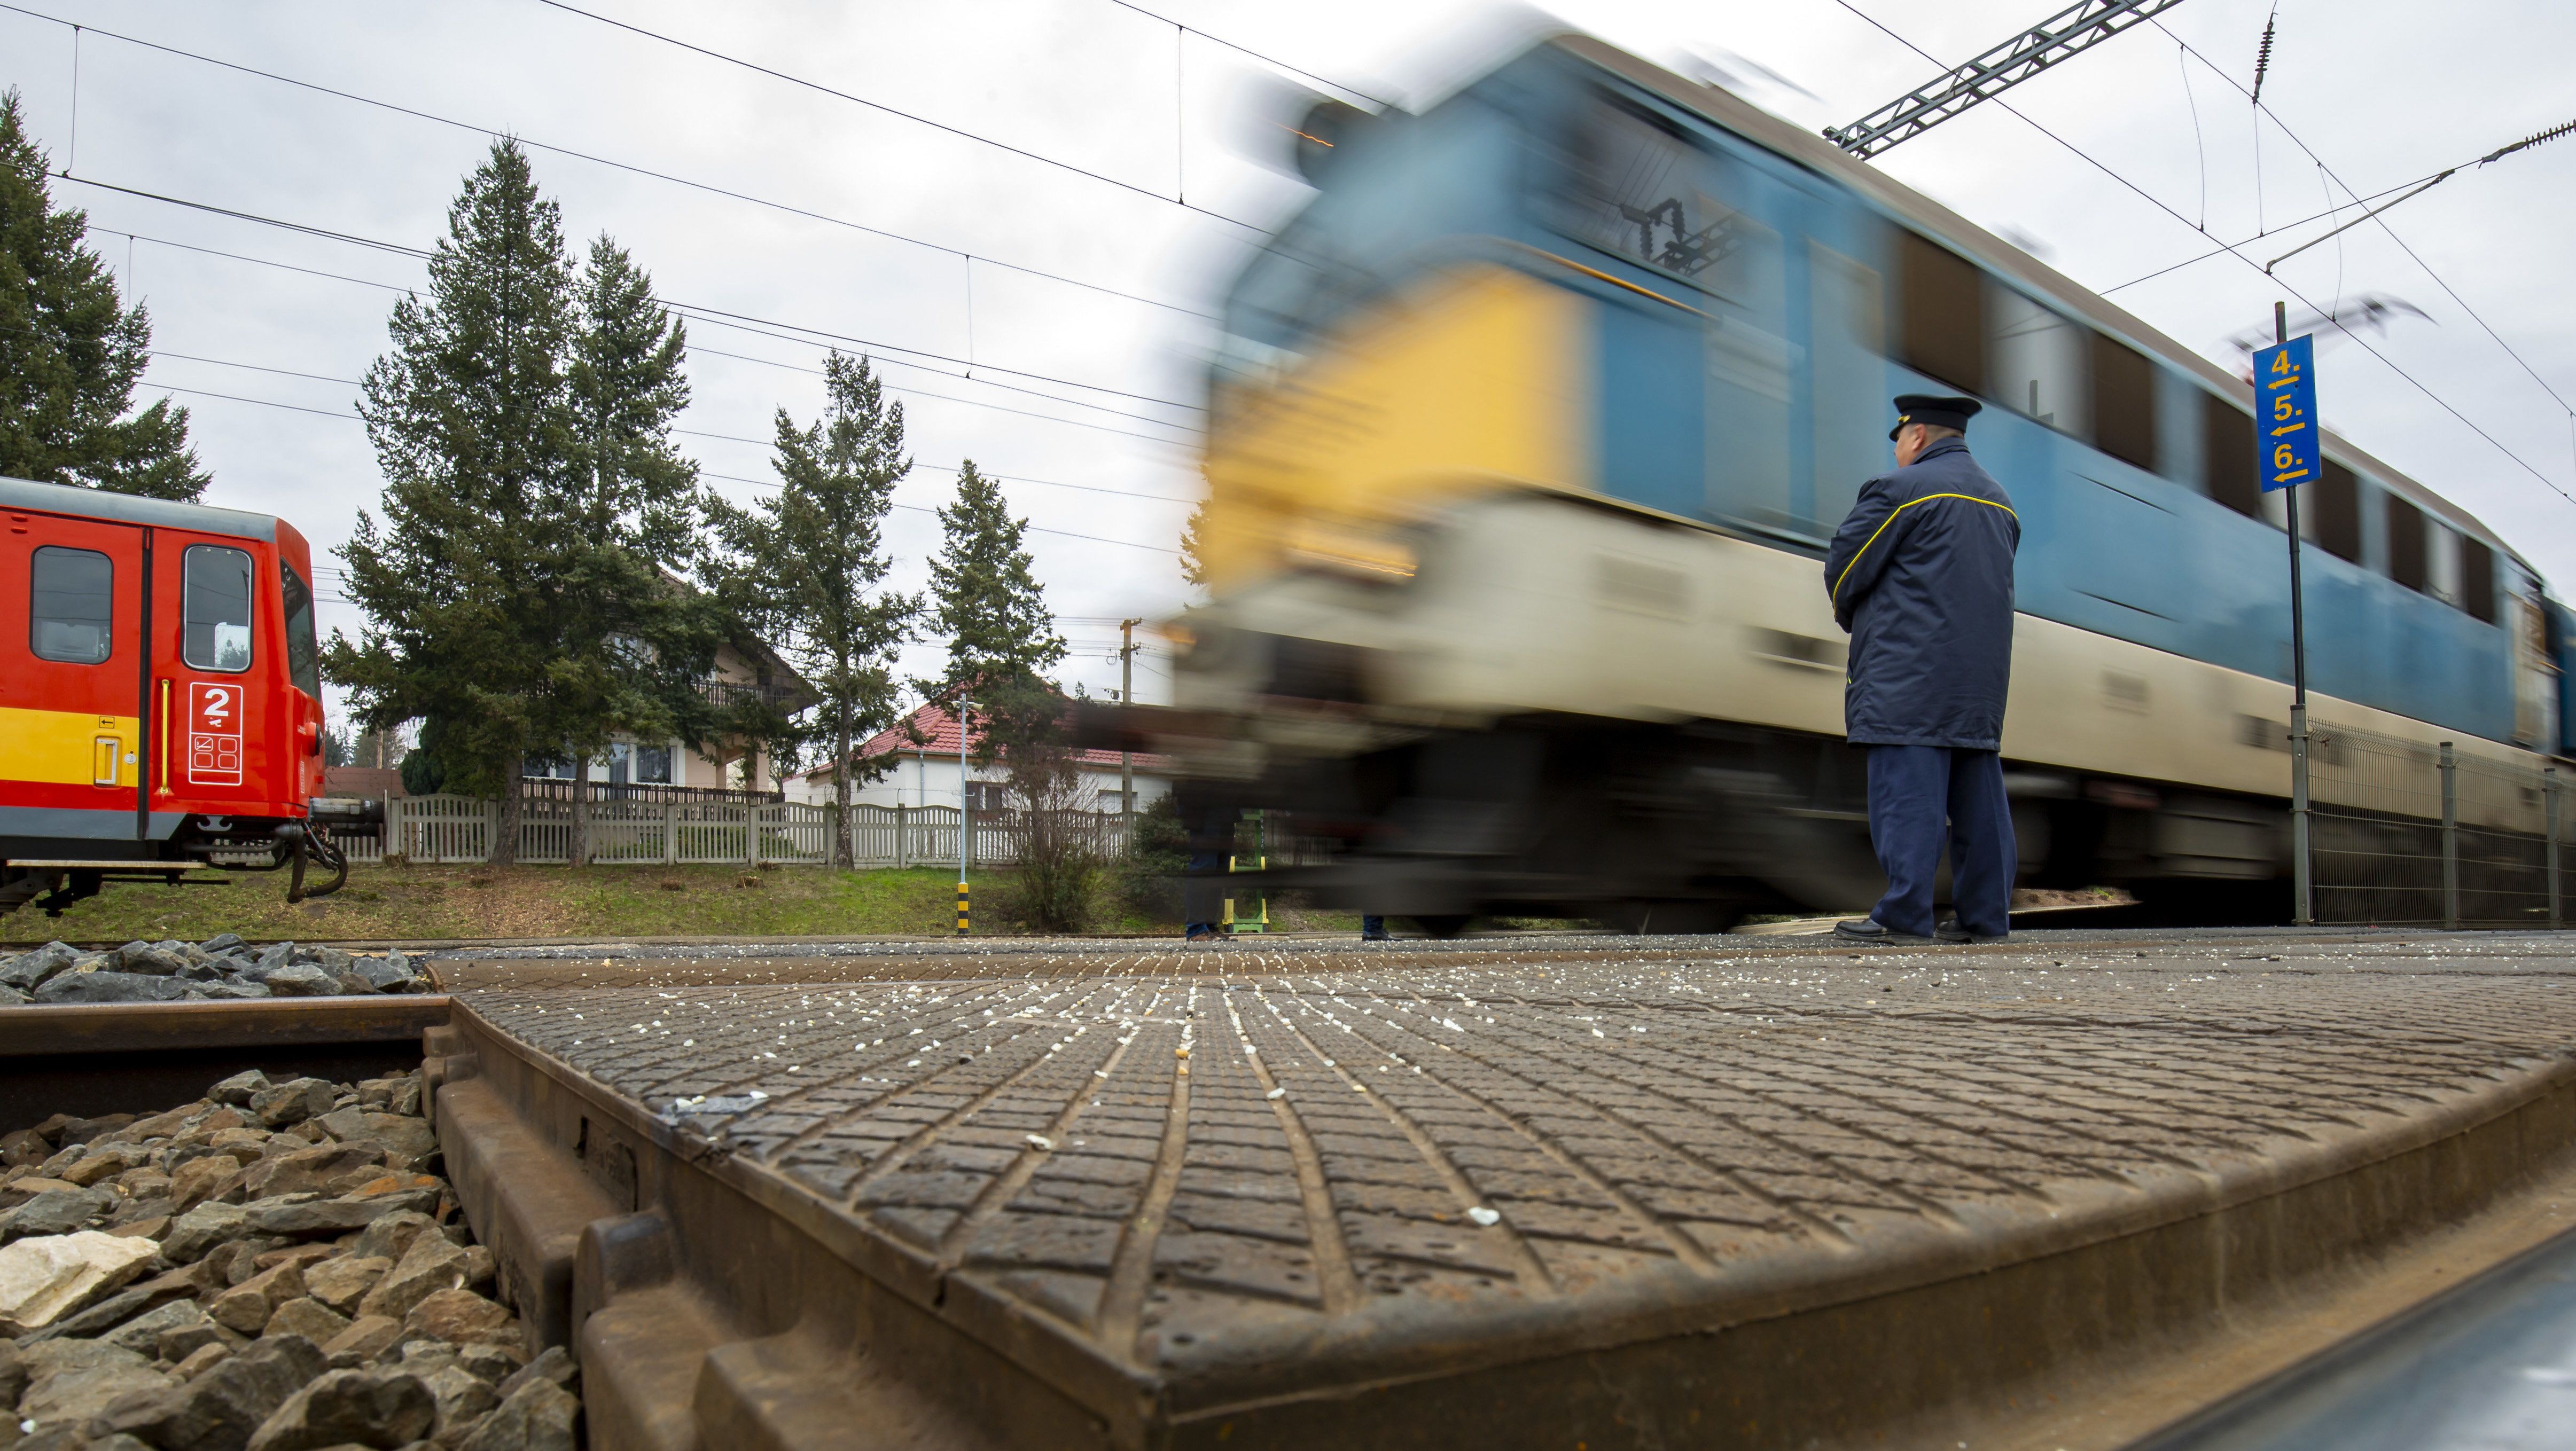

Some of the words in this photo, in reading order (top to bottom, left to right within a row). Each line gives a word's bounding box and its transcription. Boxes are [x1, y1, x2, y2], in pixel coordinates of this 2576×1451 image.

[2271, 350, 2300, 375] 4.
[2274, 394, 2302, 421] 5.
[2274, 443, 2302, 469] 6.
[204, 688, 229, 717] 2
